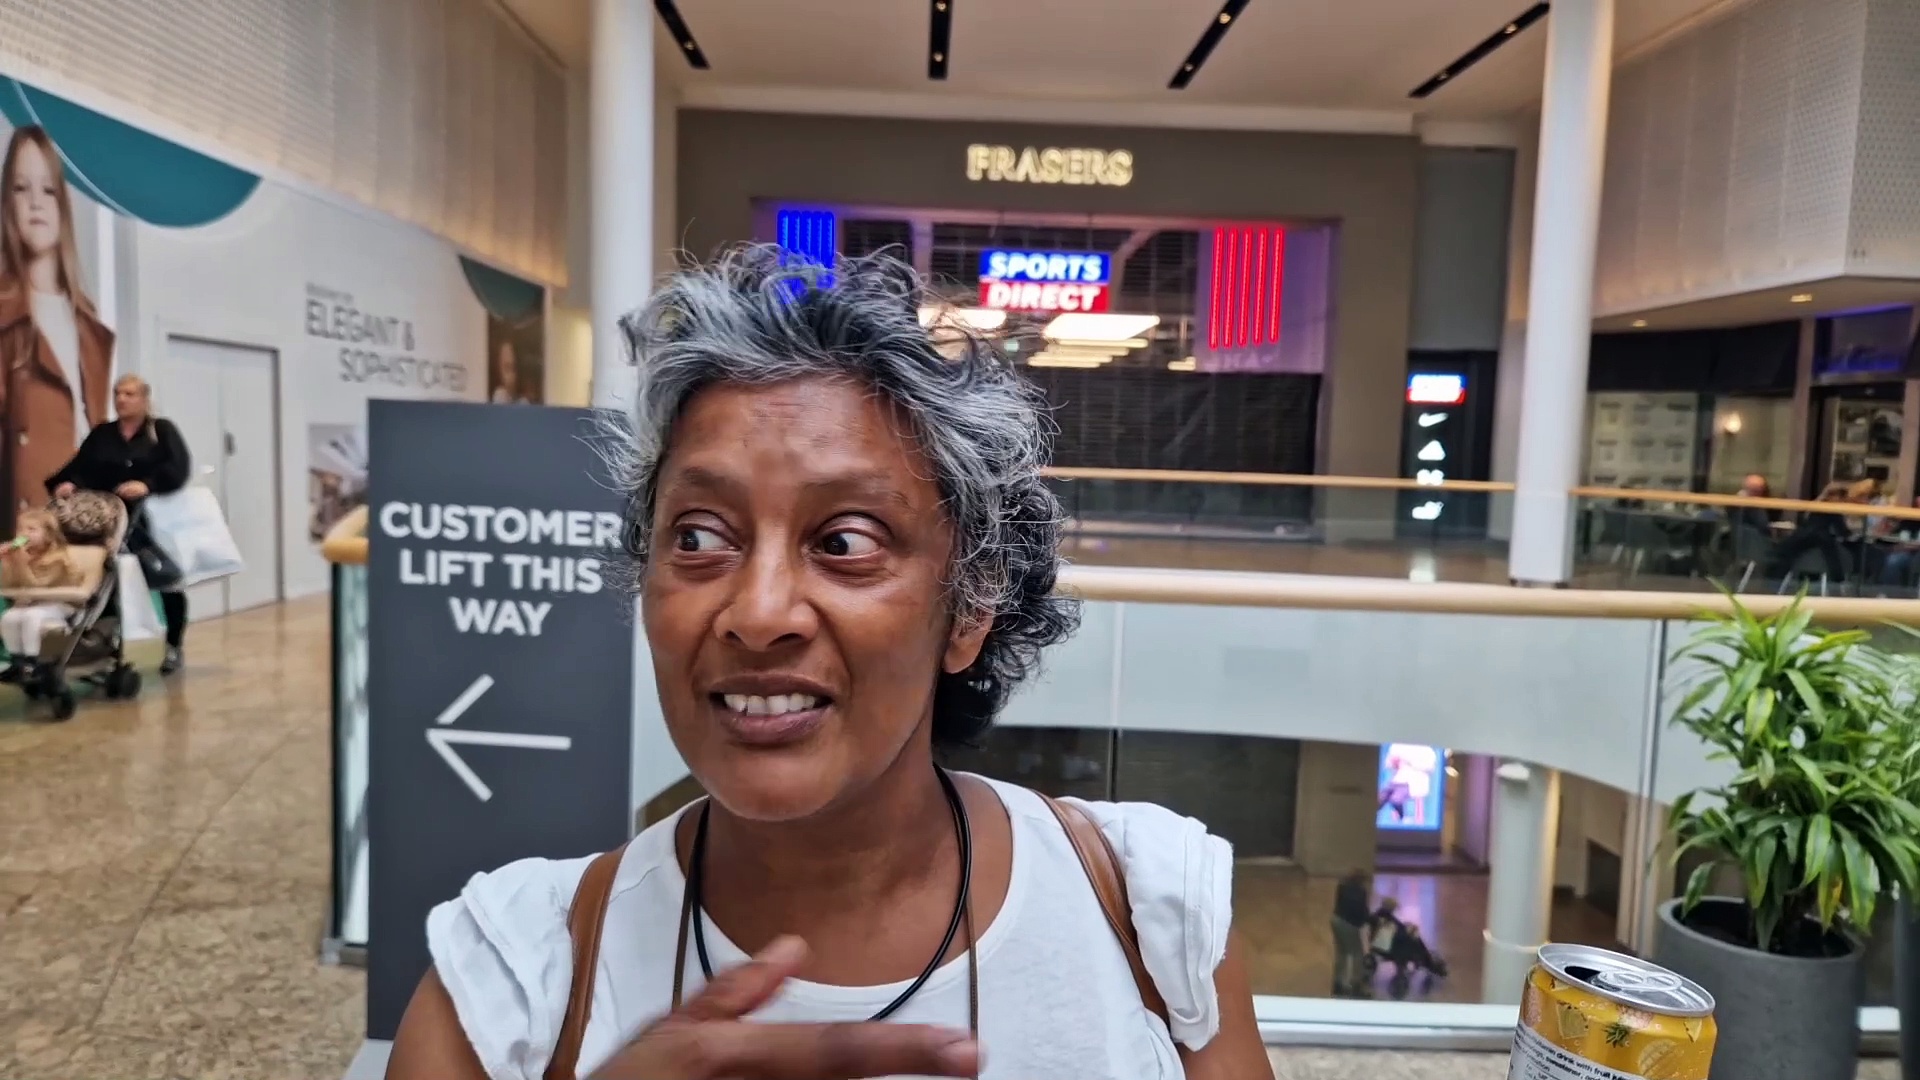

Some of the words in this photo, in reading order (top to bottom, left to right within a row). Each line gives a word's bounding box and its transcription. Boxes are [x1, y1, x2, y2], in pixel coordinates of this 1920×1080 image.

[967, 144, 1133, 186] FRASERS
[989, 252, 1102, 281] SPORTS
[987, 283, 1101, 311] DIRECT
[306, 299, 399, 346] ELEGANT
[403, 321, 415, 351] &
[339, 347, 468, 392] SOPHISTICATED
[379, 501, 622, 548] CUSTOMER
[399, 548, 494, 588] LIFT
[501, 553, 604, 594] THIS
[448, 596, 553, 637] WAY
[1556, 1052, 1575, 1064] drink
[1576, 1061, 1593, 1073] with
[1594, 1067, 1611, 1078] fruit
